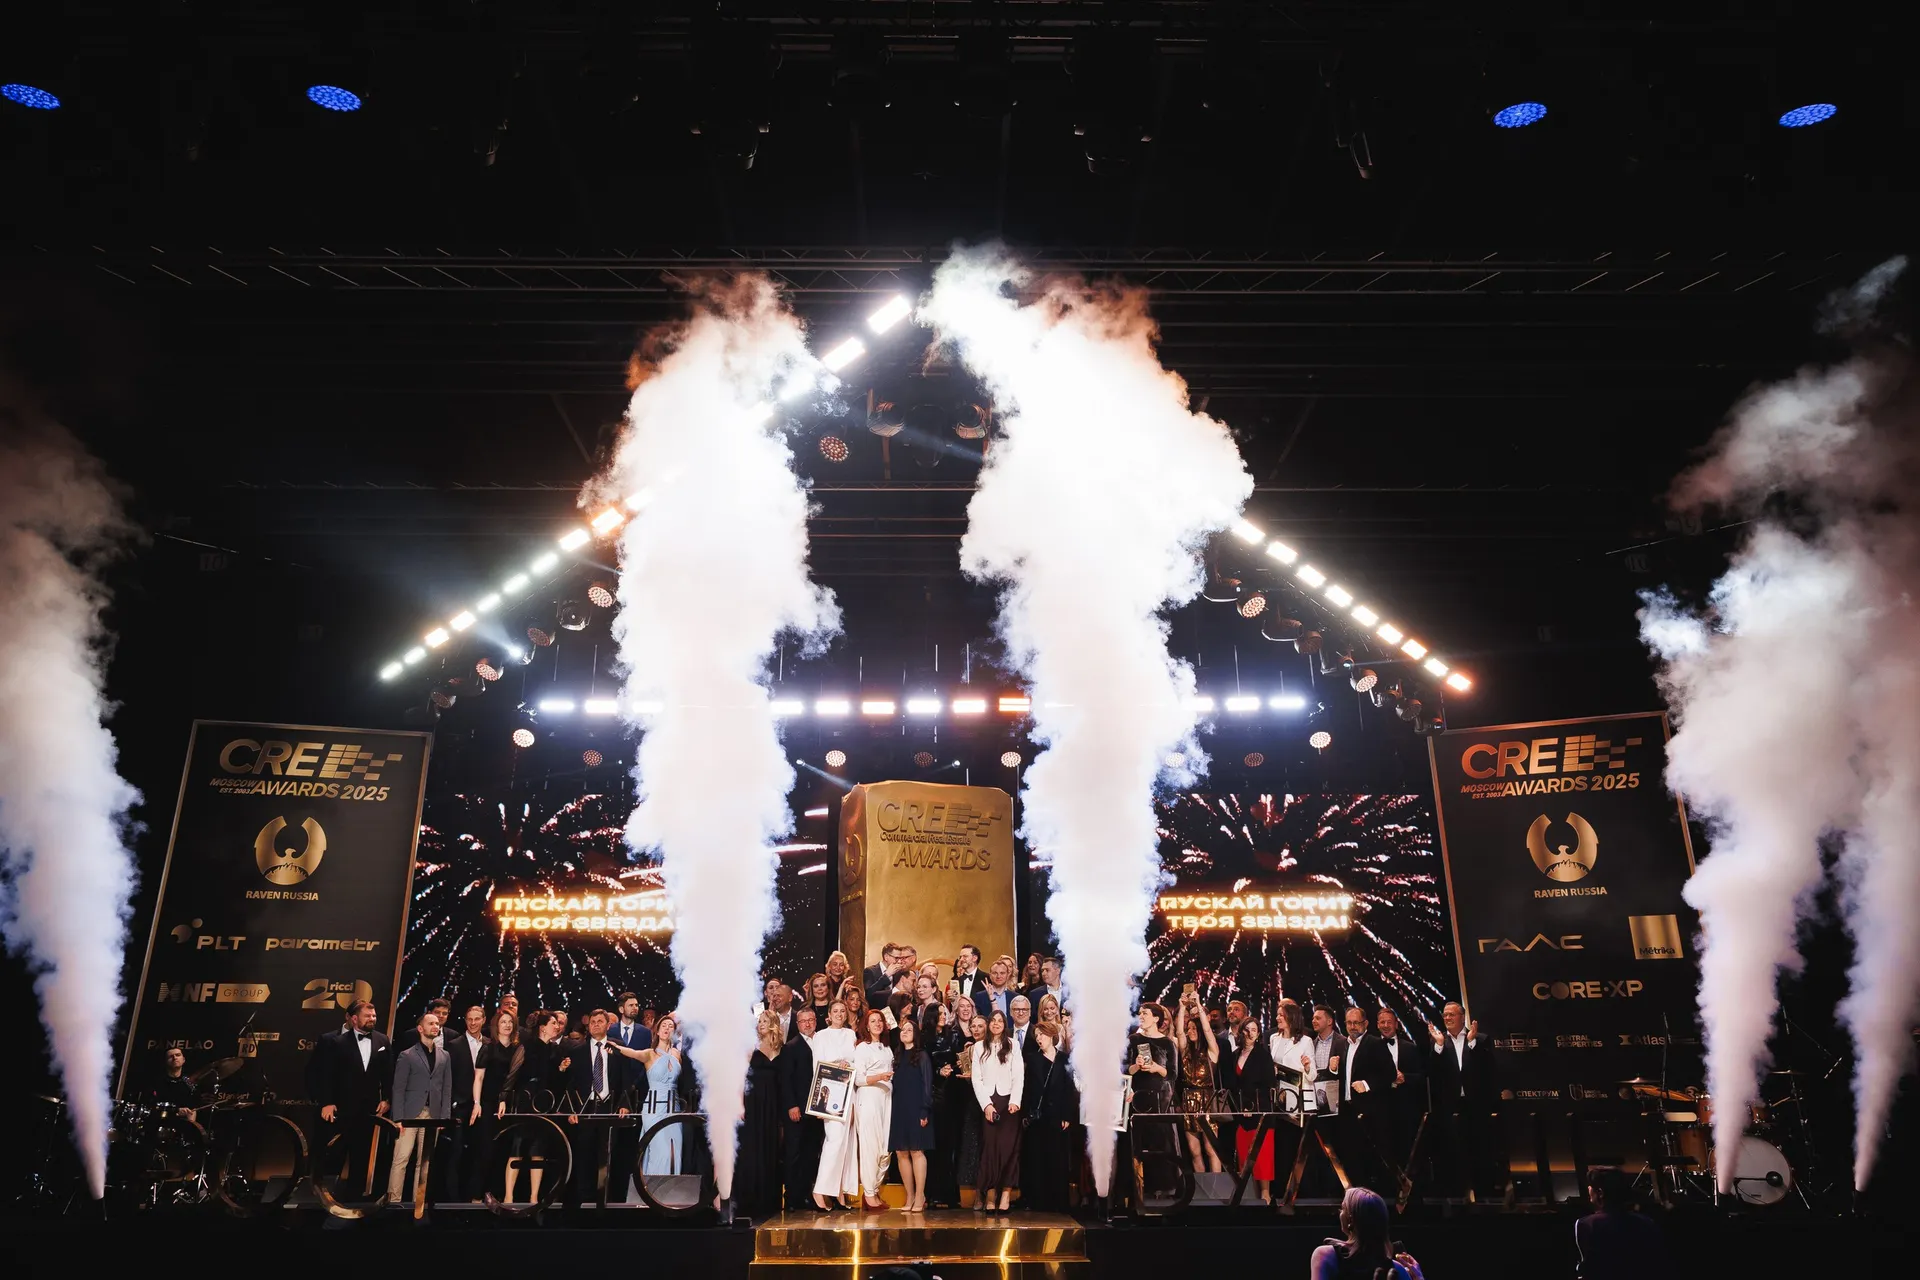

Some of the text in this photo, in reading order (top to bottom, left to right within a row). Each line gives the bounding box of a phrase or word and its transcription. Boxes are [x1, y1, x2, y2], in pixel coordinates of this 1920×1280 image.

[209, 778, 257, 788] MOSCOW
[1460, 782, 1506, 793] MOSCOW
[1502, 772, 1640, 797] AWARDS 2025
[250, 780, 391, 801] AWARDS 2025
[893, 844, 991, 871] AWARDS
[246, 890, 319, 901] RAVEN RUSSIA
[1534, 886, 1608, 898] RAVEN RUSSIA
[494, 896, 680, 911] ПУСКАЙ ГОРИ
[1160, 894, 1353, 910] ПУСКАЙ ГОРИТ
[499, 916, 568, 930] ТВОЯ
[1166, 915, 1348, 929] ТВОЯ ЗВЕЗДА!
[197, 935, 246, 950] PLT
[265, 937, 380, 951] parametr
[223, 988, 264, 998] GROUP
[330, 982, 354, 991] ricci
[1556, 1034, 1590, 1042] CENTRAL
[1557, 1040, 1603, 1048] PROPERTIES
